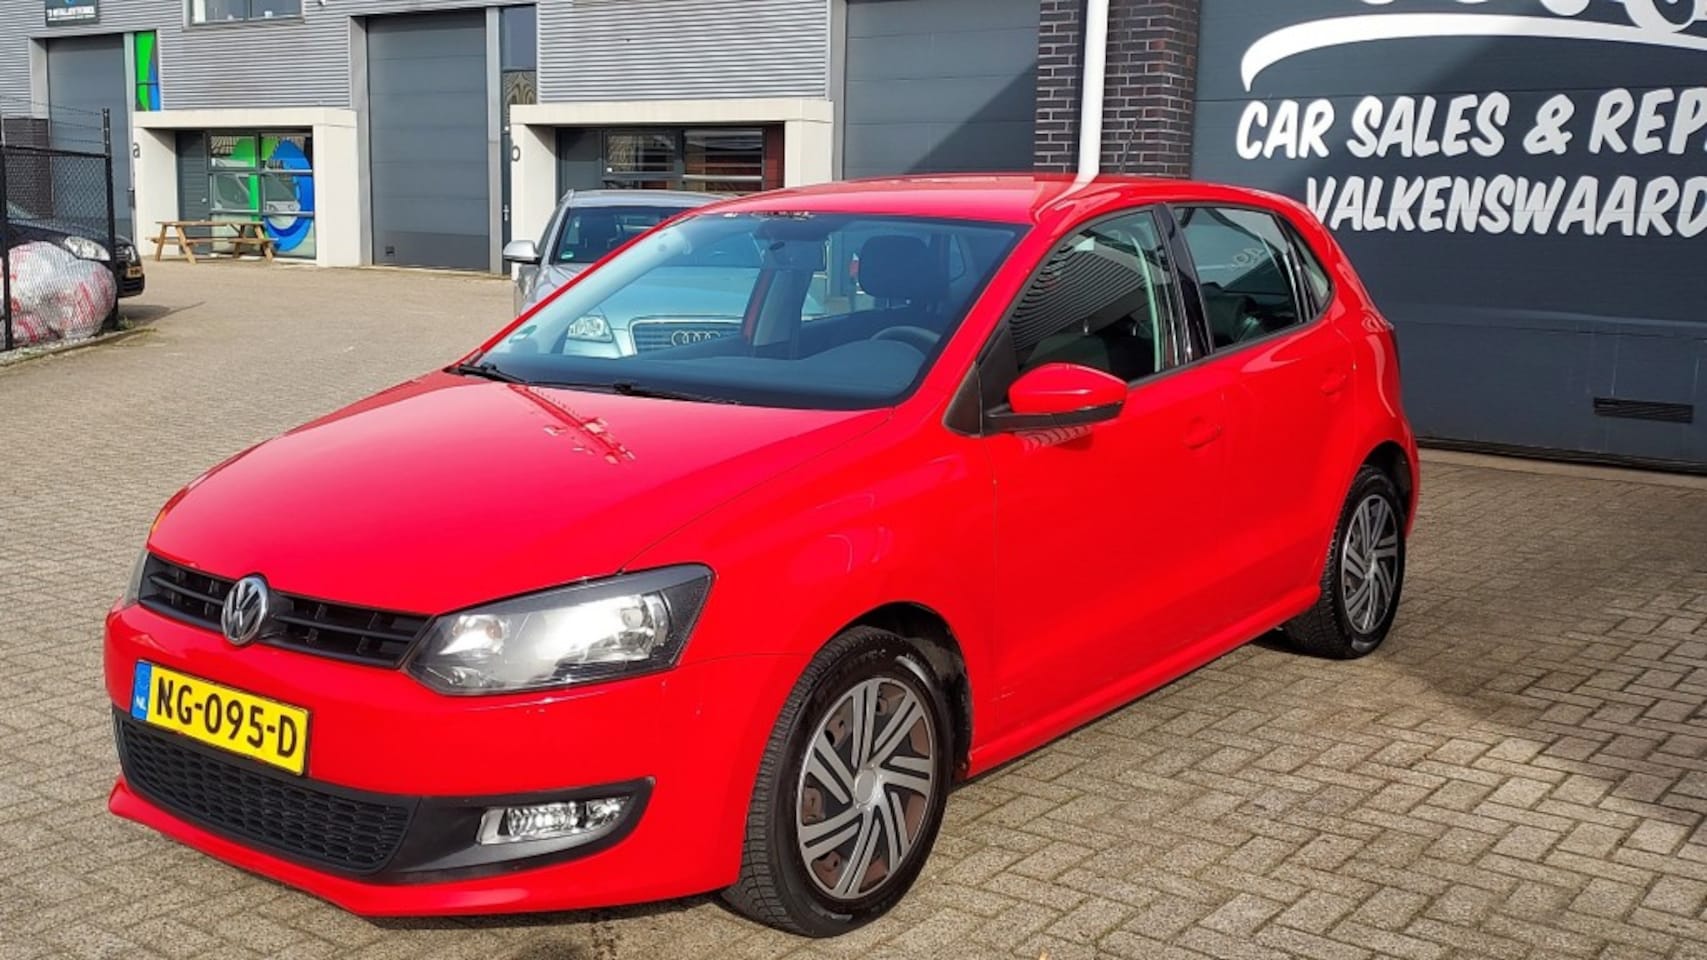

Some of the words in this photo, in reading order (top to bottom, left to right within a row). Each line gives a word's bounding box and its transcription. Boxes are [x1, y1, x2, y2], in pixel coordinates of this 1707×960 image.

[1236, 98, 1335, 159] CAR
[1346, 91, 1510, 158] SALES
[1522, 93, 1575, 155] &
[1588, 87, 1707, 155] REP
[1306, 174, 1707, 238] VALKENSWAARD
[156, 676, 298, 759] NG-095-D
